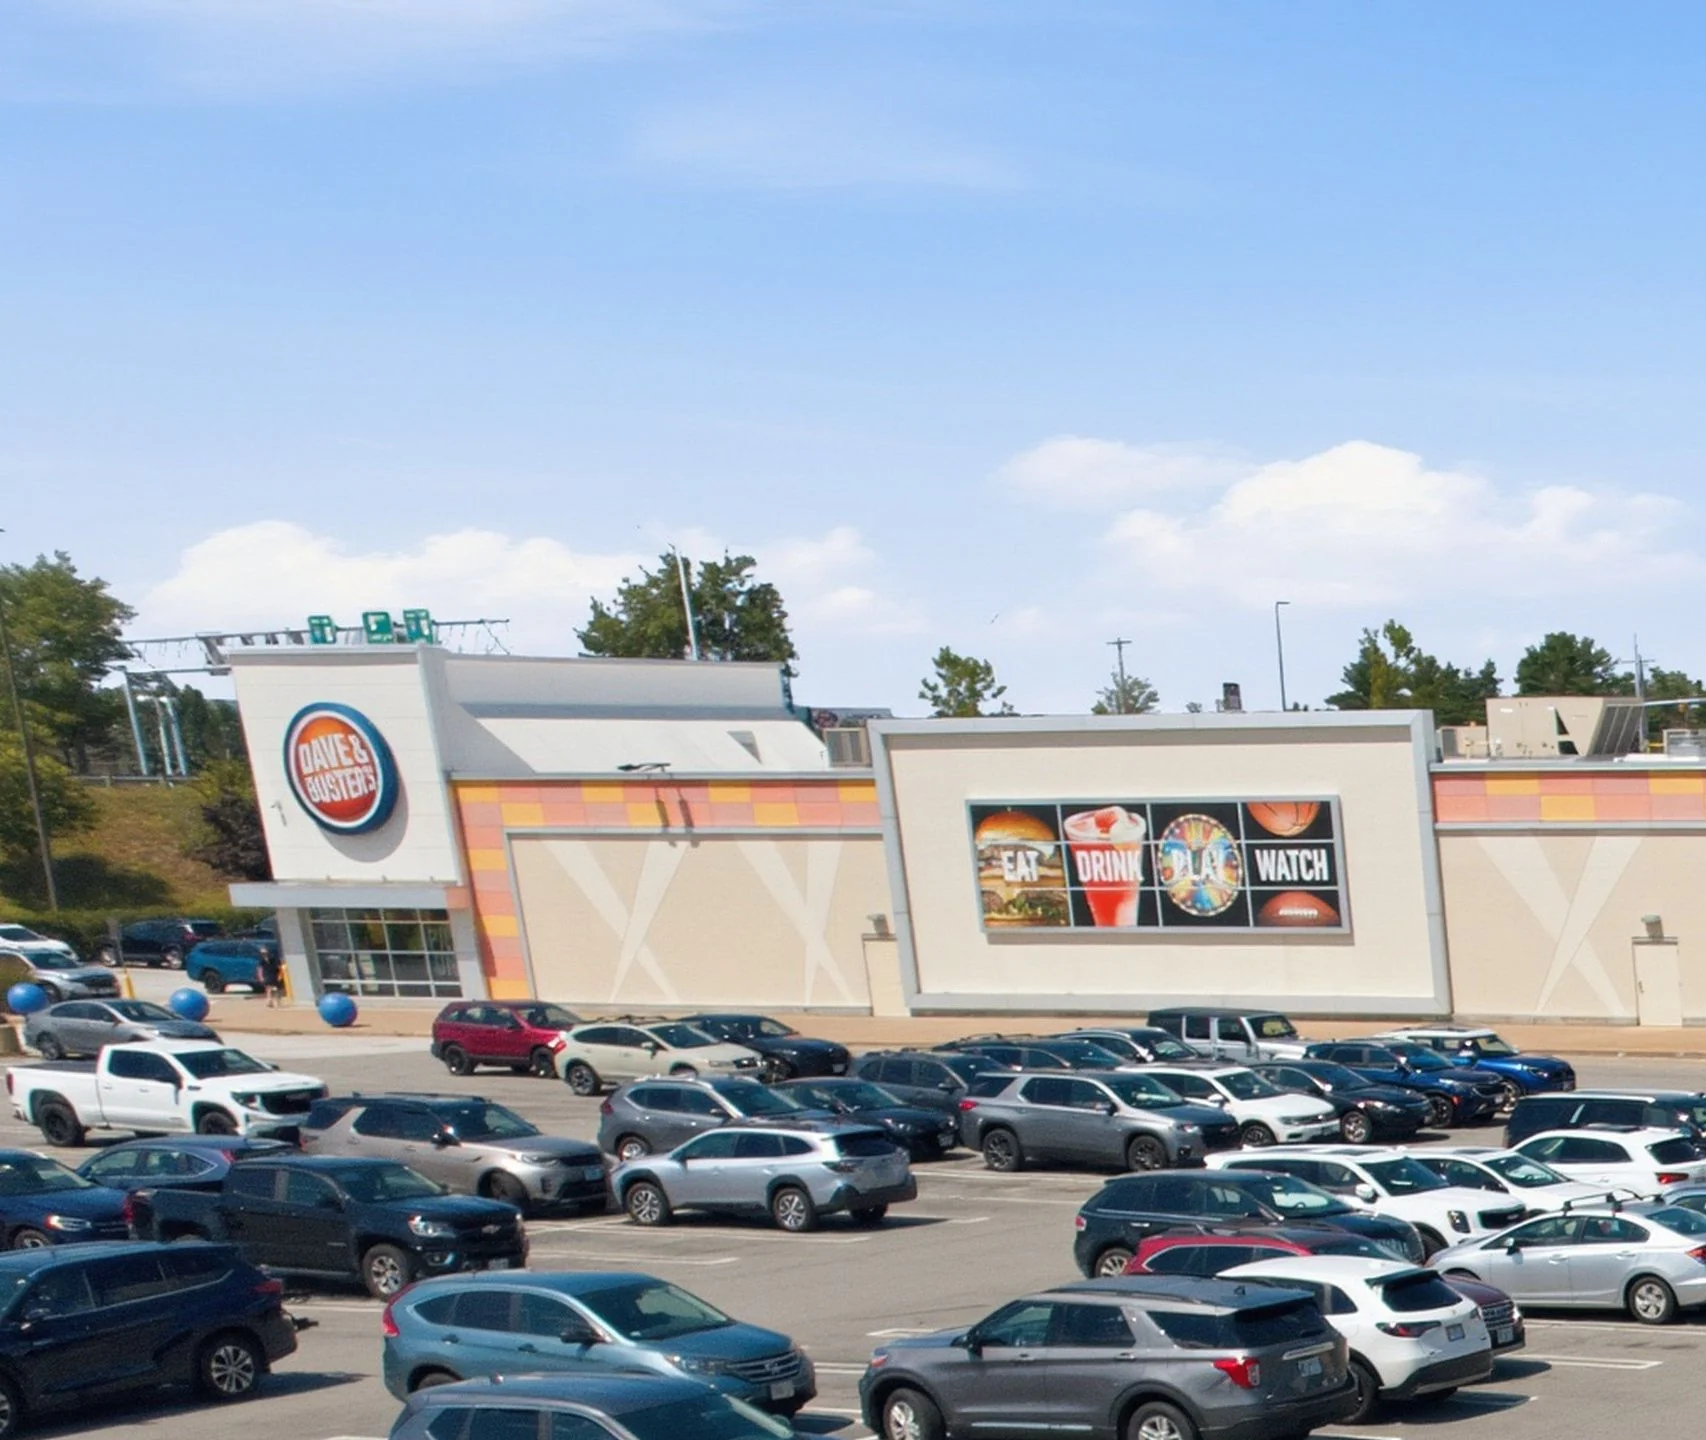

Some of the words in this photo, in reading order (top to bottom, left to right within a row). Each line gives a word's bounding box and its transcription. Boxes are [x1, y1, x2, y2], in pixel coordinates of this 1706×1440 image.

[299, 734, 353, 775] DAVE
[348, 734, 370, 764] &
[303, 765, 377, 802] BUSTER'S
[1001, 850, 1039, 882] EAT
[1075, 849, 1144, 883] DRINK
[1172, 849, 1227, 882] PLAY
[1255, 848, 1329, 882] WATCH
